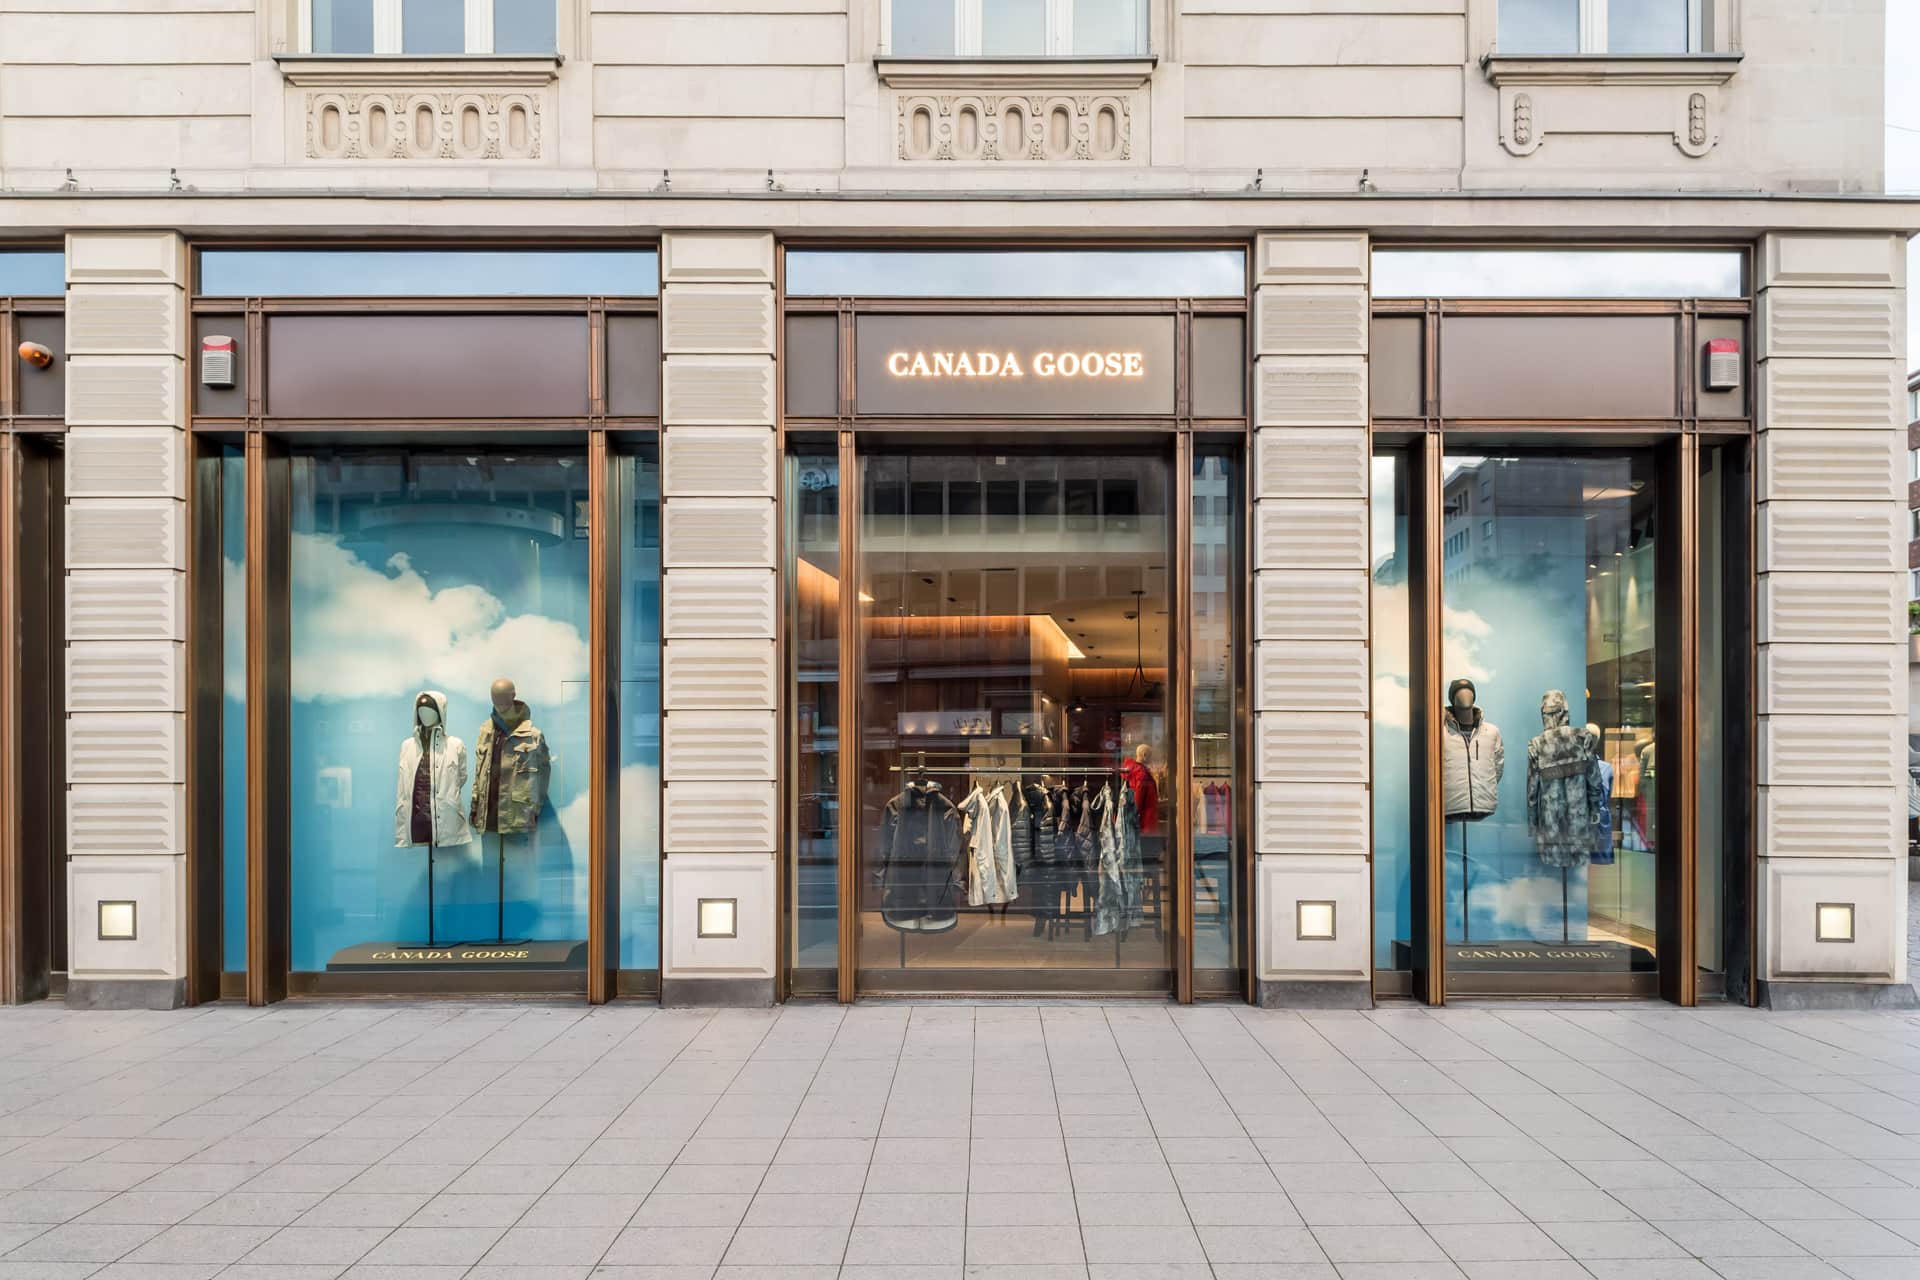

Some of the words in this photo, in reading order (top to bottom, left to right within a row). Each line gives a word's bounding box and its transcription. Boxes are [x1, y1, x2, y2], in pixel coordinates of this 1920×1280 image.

[888, 352, 1024, 377] CANADA
[1033, 352, 1145, 377] GOOSE
[371, 951, 454, 960] CANADA
[461, 950, 529, 960] GOOSE
[1457, 950, 1541, 960] CANADA
[1546, 950, 1616, 960] GOOSE
